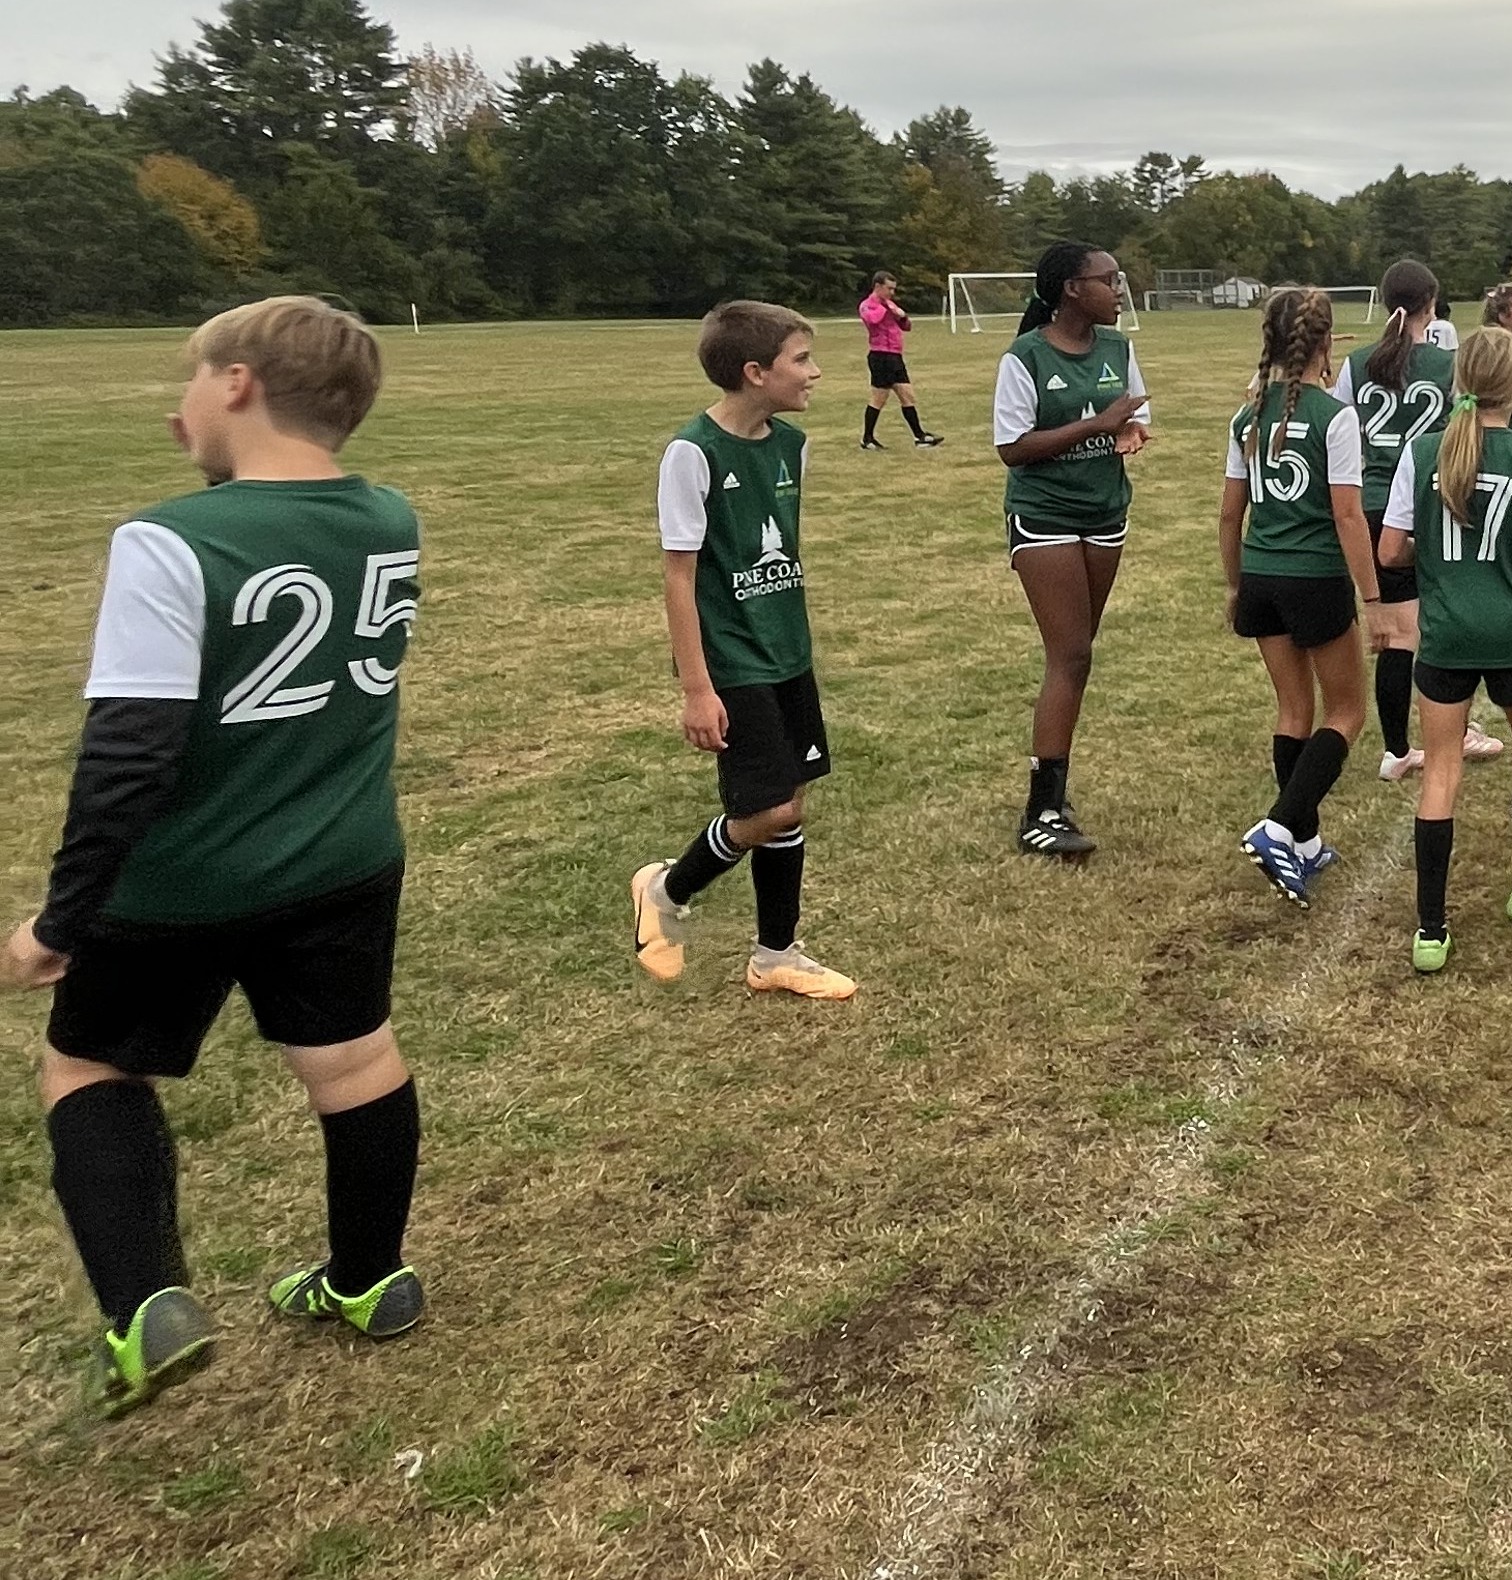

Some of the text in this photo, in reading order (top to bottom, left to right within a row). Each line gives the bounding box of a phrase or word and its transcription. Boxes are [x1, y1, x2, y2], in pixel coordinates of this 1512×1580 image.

[1426, 329, 1441, 346] 15
[1357, 380, 1444, 448] 22
[1241, 421, 1311, 504] 15
[732, 568, 765, 588] PNE
[219, 549, 421, 724] 25
